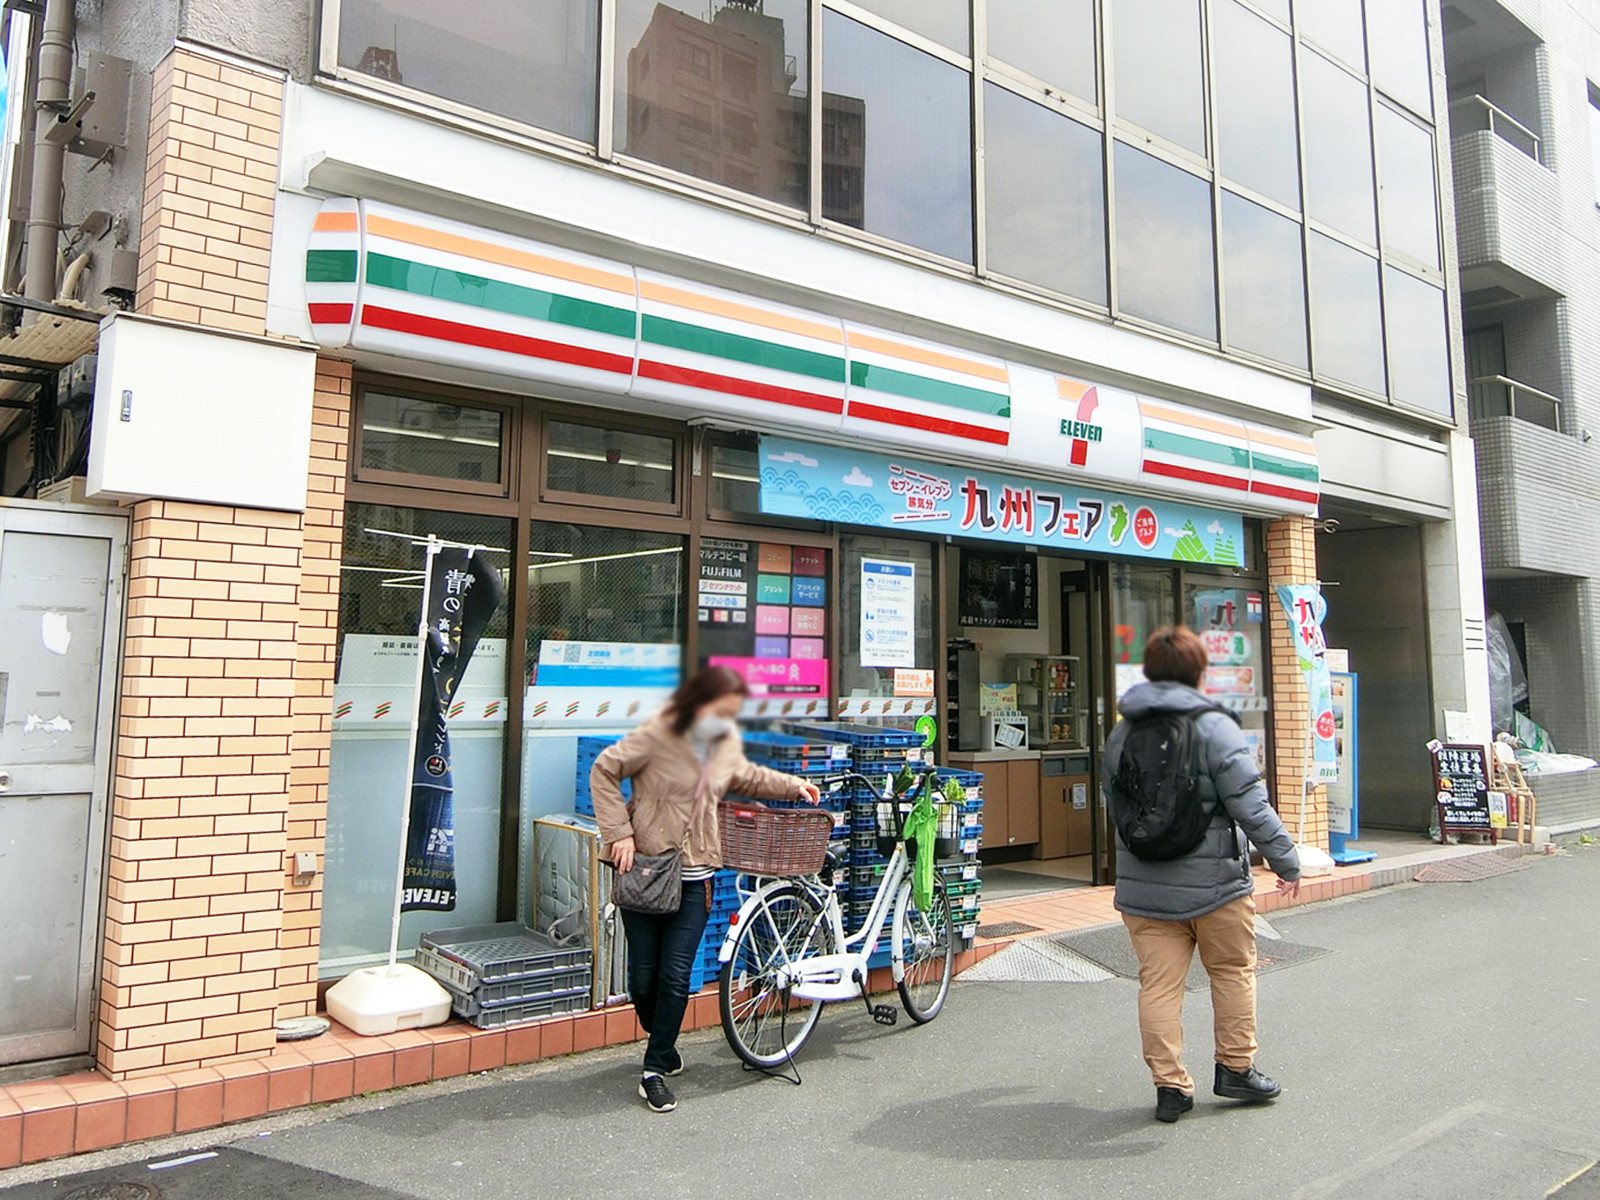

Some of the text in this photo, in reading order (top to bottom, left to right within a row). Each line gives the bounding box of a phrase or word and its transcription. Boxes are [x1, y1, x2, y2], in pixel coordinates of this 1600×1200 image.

[960, 479, 1103, 539] 九州フェア
[701, 565, 742, 578] FUJIFILM
